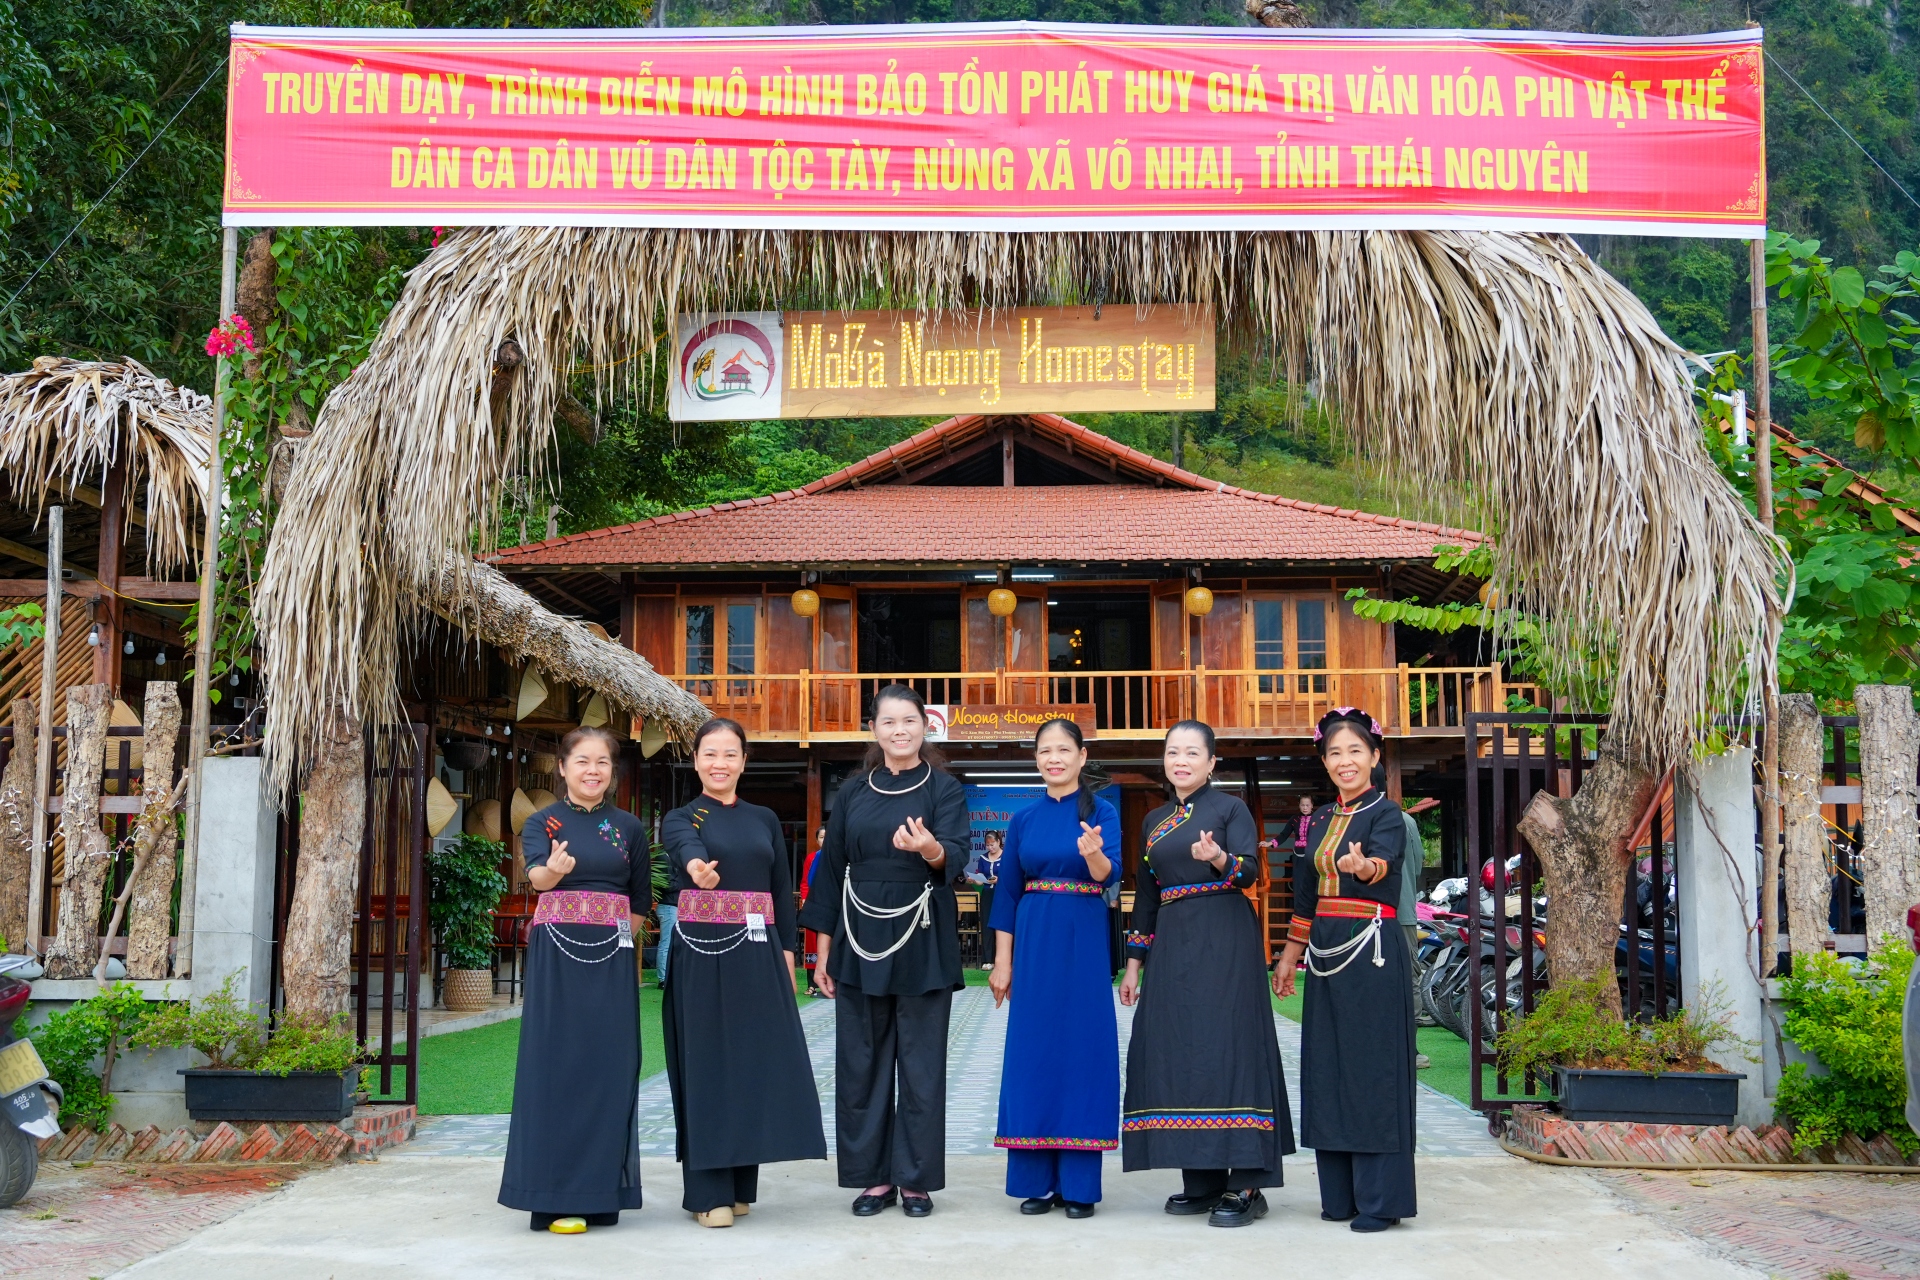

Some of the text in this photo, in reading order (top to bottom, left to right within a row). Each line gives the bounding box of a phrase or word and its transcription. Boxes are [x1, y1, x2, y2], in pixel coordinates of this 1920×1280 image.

[262, 57, 1731, 129] TRUYỀN DẠY, TRÌNH DIỄN MÔ HÌNH BẢO TỒN PHÁT HUY GIÁ TRỊ VĂN HÓA PHI VẬT THỂ
[391, 131, 1589, 201] DÂN CA DÂN VŨ DÂN TỘC TÀY, NÙNG XÃ VÕ NHAI, TỈNH THÁI NGUYÊN
[1017, 317, 1195, 400] Homestay
